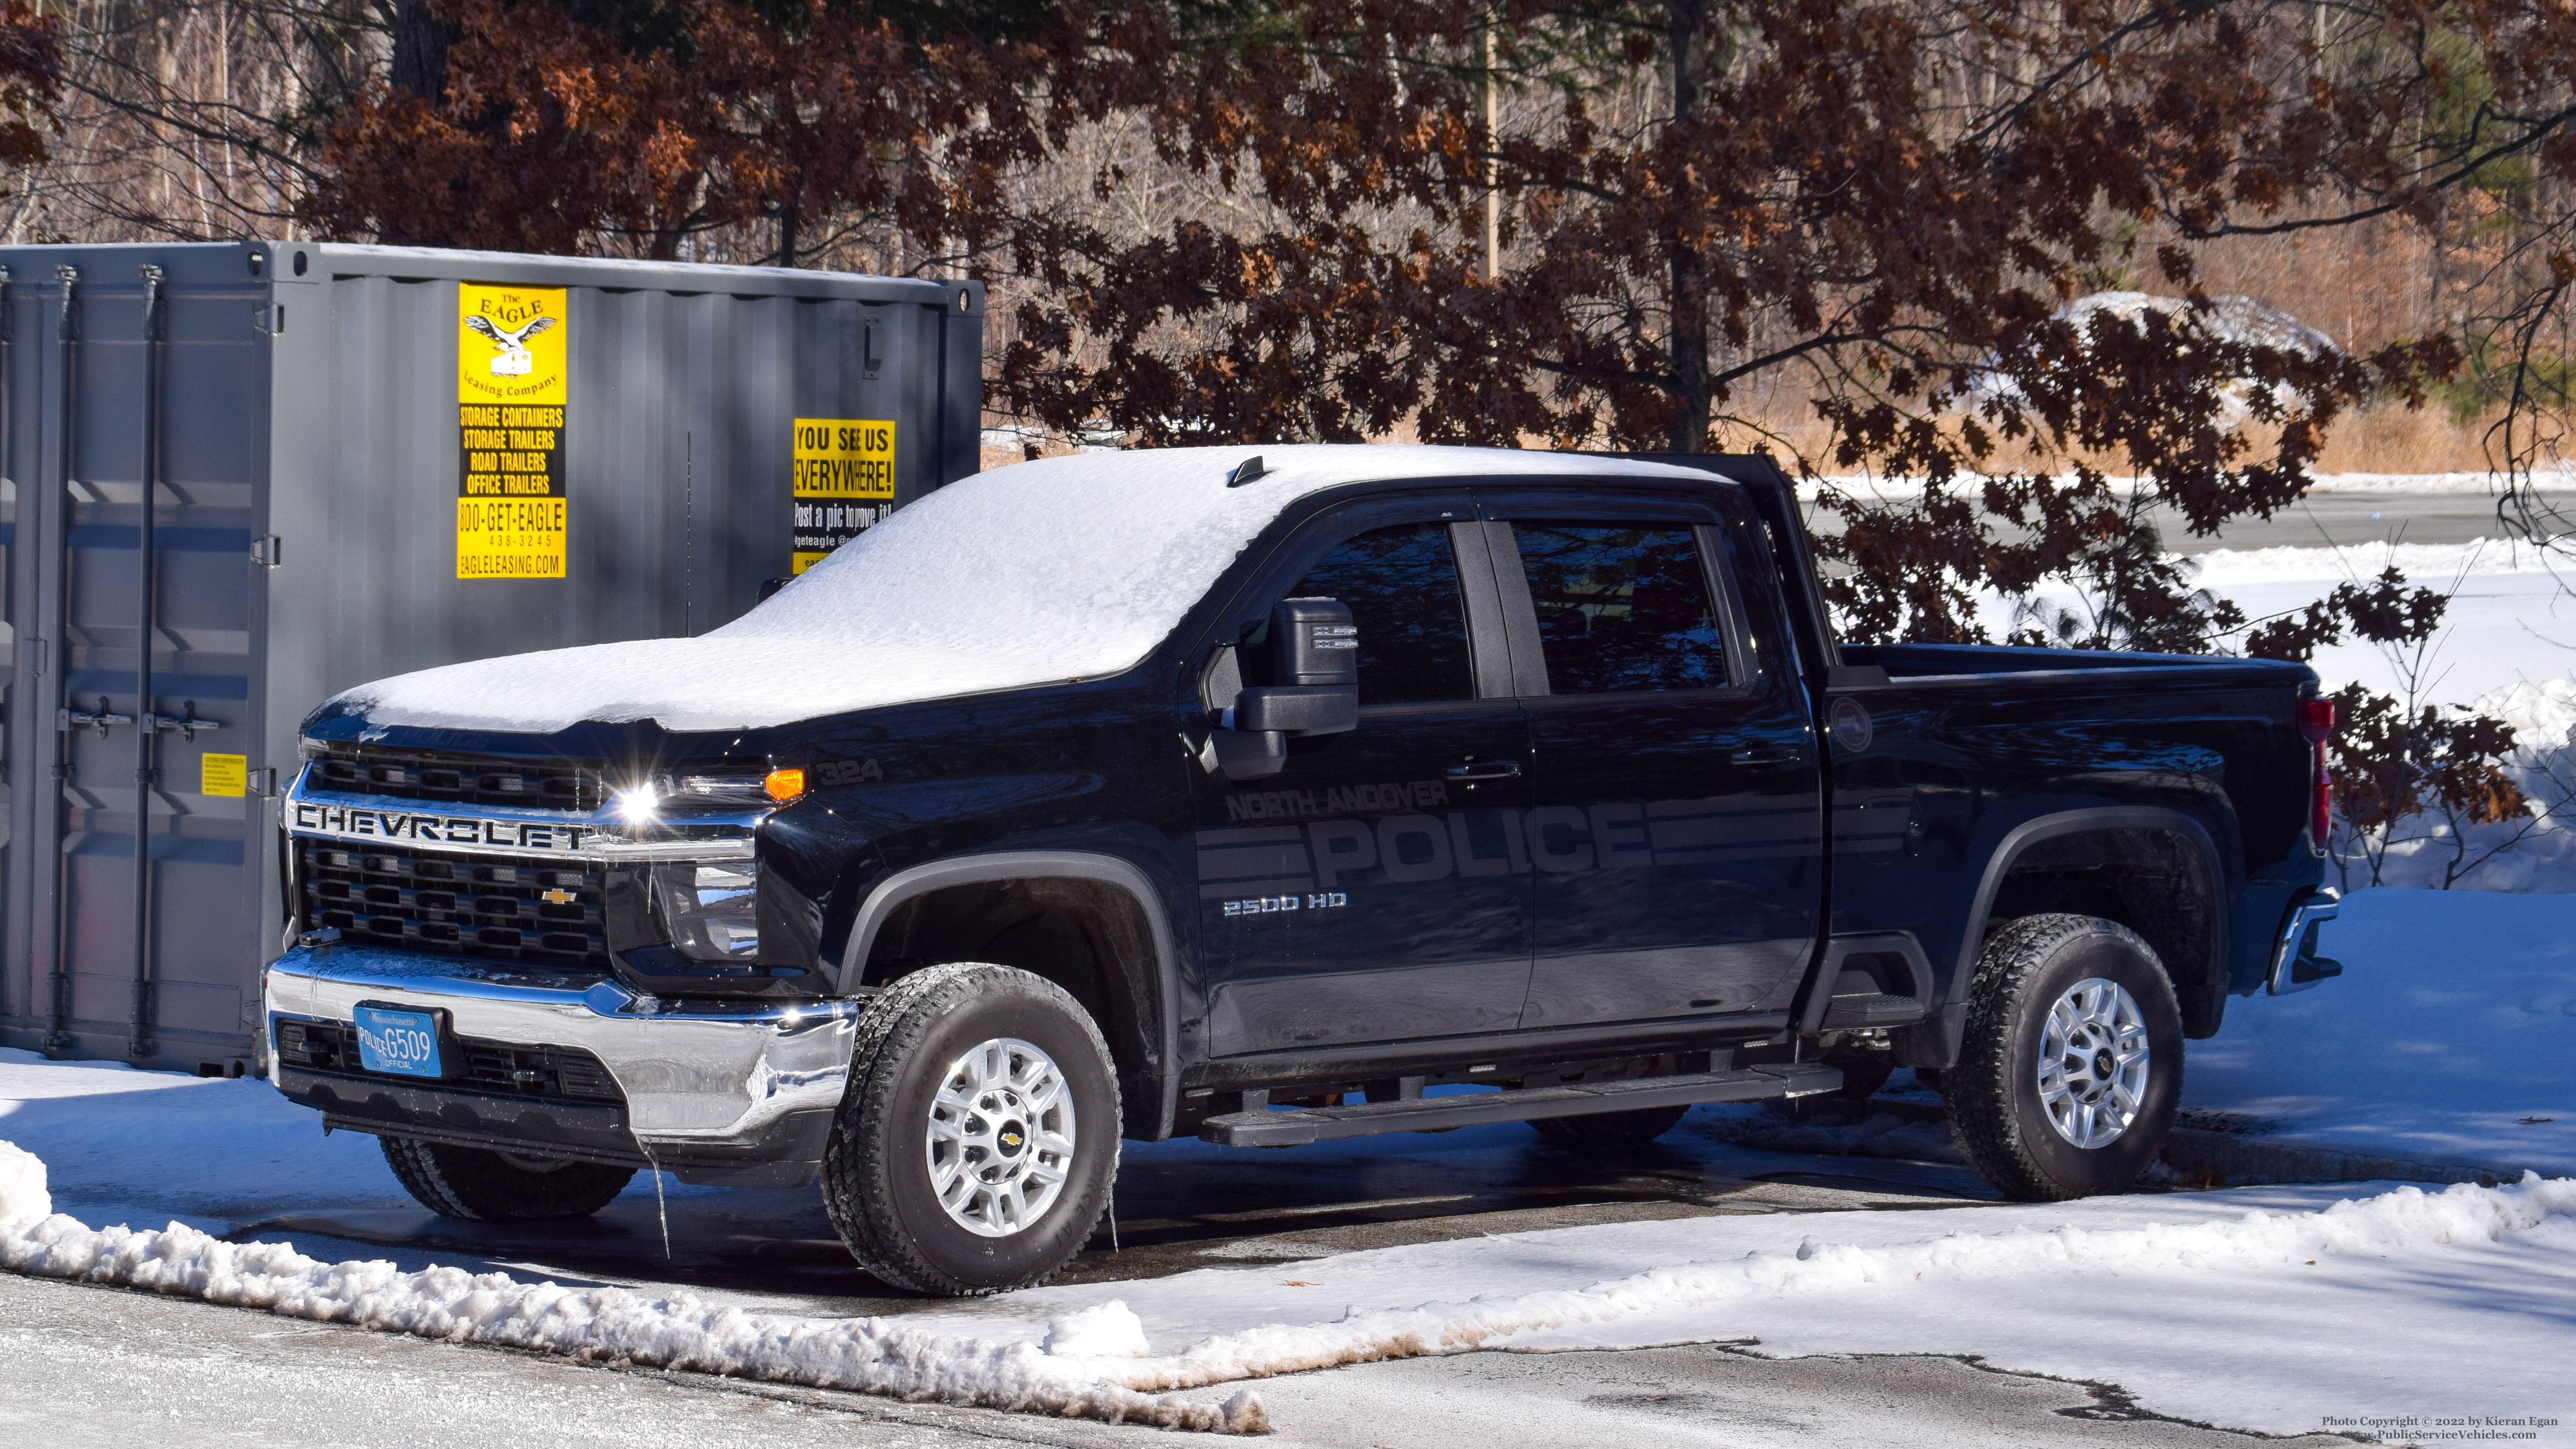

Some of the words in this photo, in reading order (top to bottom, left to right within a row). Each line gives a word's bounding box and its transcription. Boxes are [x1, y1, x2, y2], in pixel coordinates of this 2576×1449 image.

[479, 299, 544, 323] EAGLE
[501, 294, 521, 304] The
[464, 370, 503, 398] Leasing
[507, 374, 557, 396] Company
[460, 407, 500, 427] STORAGE
[501, 407, 563, 428] CONTAINERS
[464, 429, 507, 449] STORAGE
[509, 430, 555, 450] TRAILERS
[797, 427, 829, 450] YOU
[838, 428, 861, 451] SEE
[865, 429, 889, 452] US
[471, 452, 498, 471] ROAD
[499, 453, 546, 472] TRAILERS
[467, 474, 501, 494] OFFICE
[503, 475, 550, 494] TRAILERS
[795, 459, 892, 492] EVERYWHERE!
[460, 503, 562, 532] 800-GET-EAGLE
[794, 502, 813, 527] Post
[816, 507, 823, 527] a
[826, 503, 843, 532] pic
[461, 555, 559, 574] EAGLELEASING.COM
[817, 758, 884, 785] 324
[1226, 789, 1318, 821] NORTH
[1326, 780, 1450, 813] ANDOVER
[296, 805, 593, 850] CHEVROLET
[1308, 804, 1651, 889] POLICE
[1225, 896, 1299, 916] 2500
[1309, 892, 1347, 909] HD
[371, 1013, 416, 1026] Massachusetts
[359, 1026, 387, 1056] POLICE
[385, 1028, 430, 1061] G509
[385, 1059, 412, 1069] OFFICIAL
